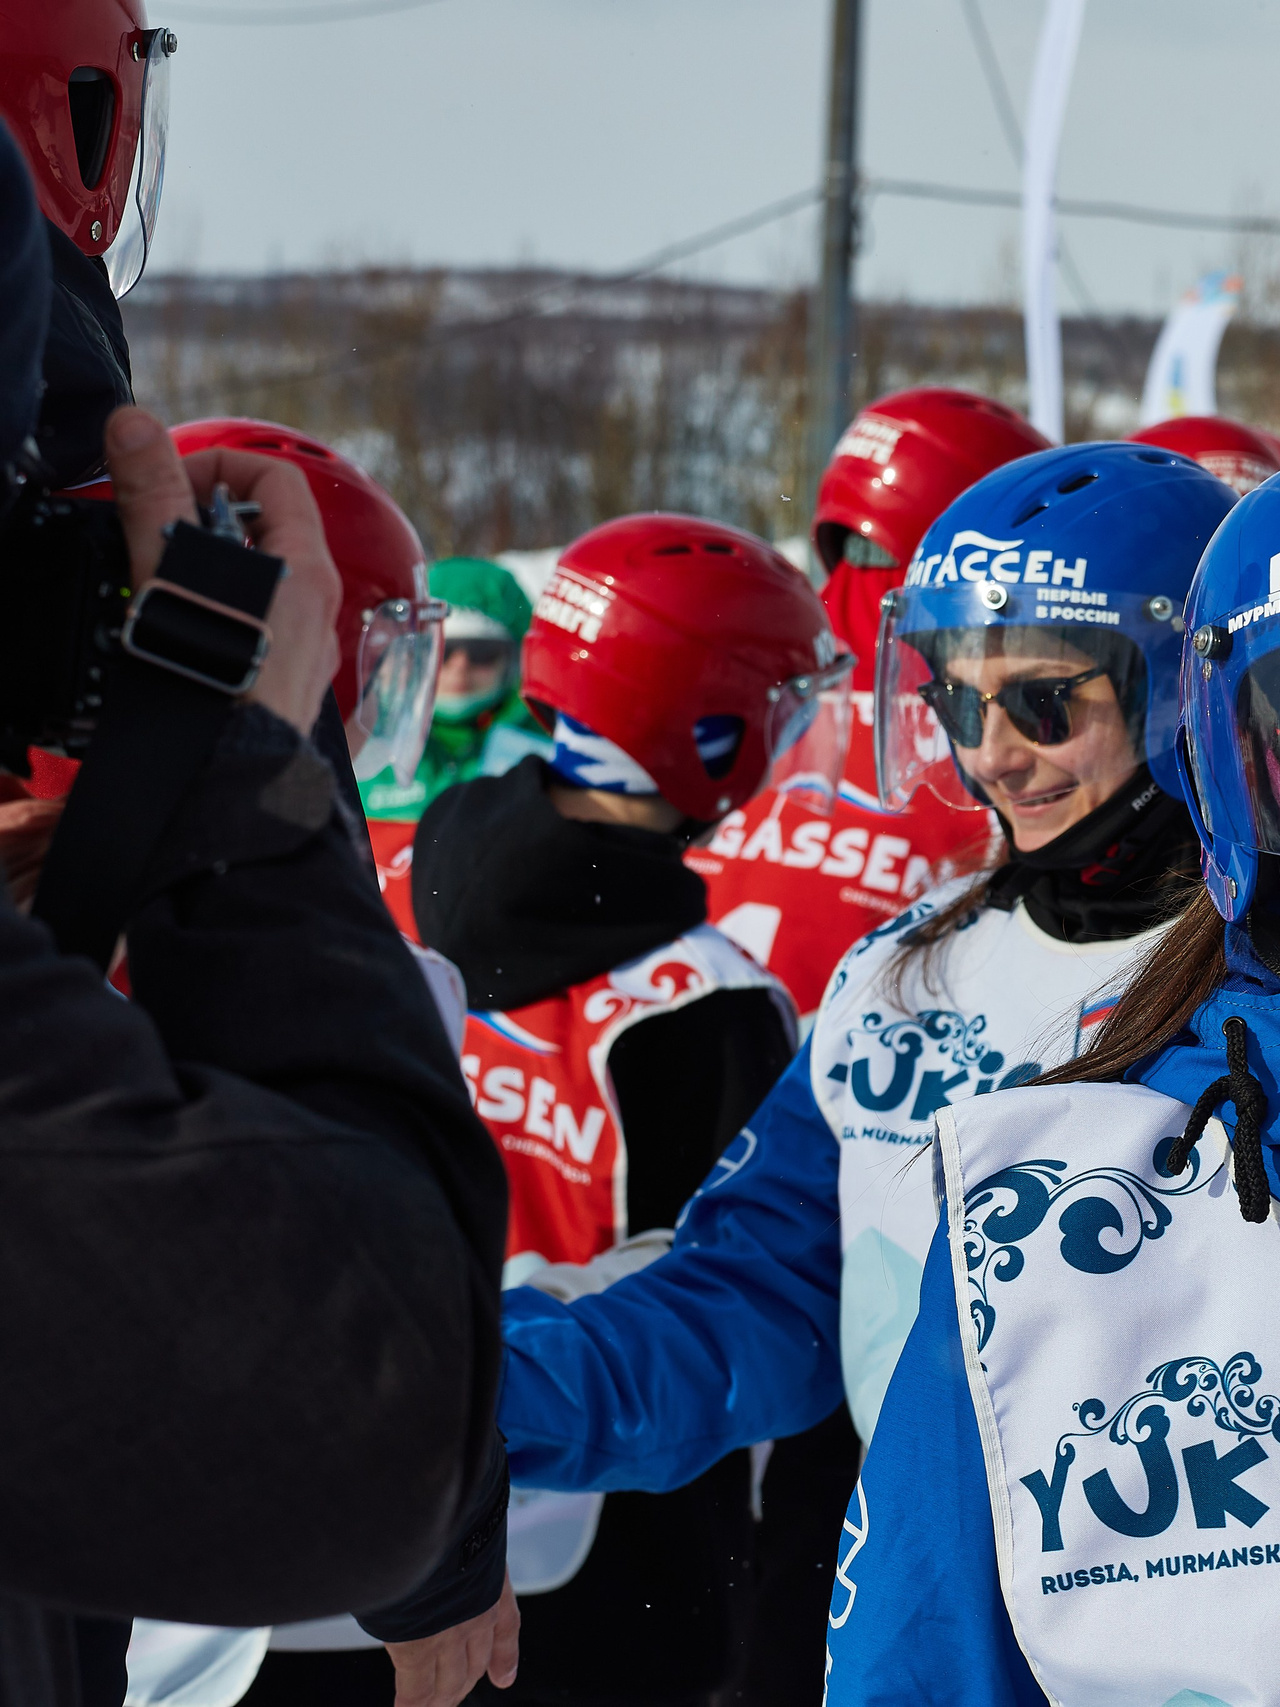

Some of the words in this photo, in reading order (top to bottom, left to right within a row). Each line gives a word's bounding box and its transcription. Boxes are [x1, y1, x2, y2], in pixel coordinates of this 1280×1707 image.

[1036, 587, 1108, 606] ПЕРВЫЕ
[1036, 604, 1049, 620] В
[1051, 607, 1121, 626] РОССИИ
[1041, 1561, 1140, 1596] RUSSIA,
